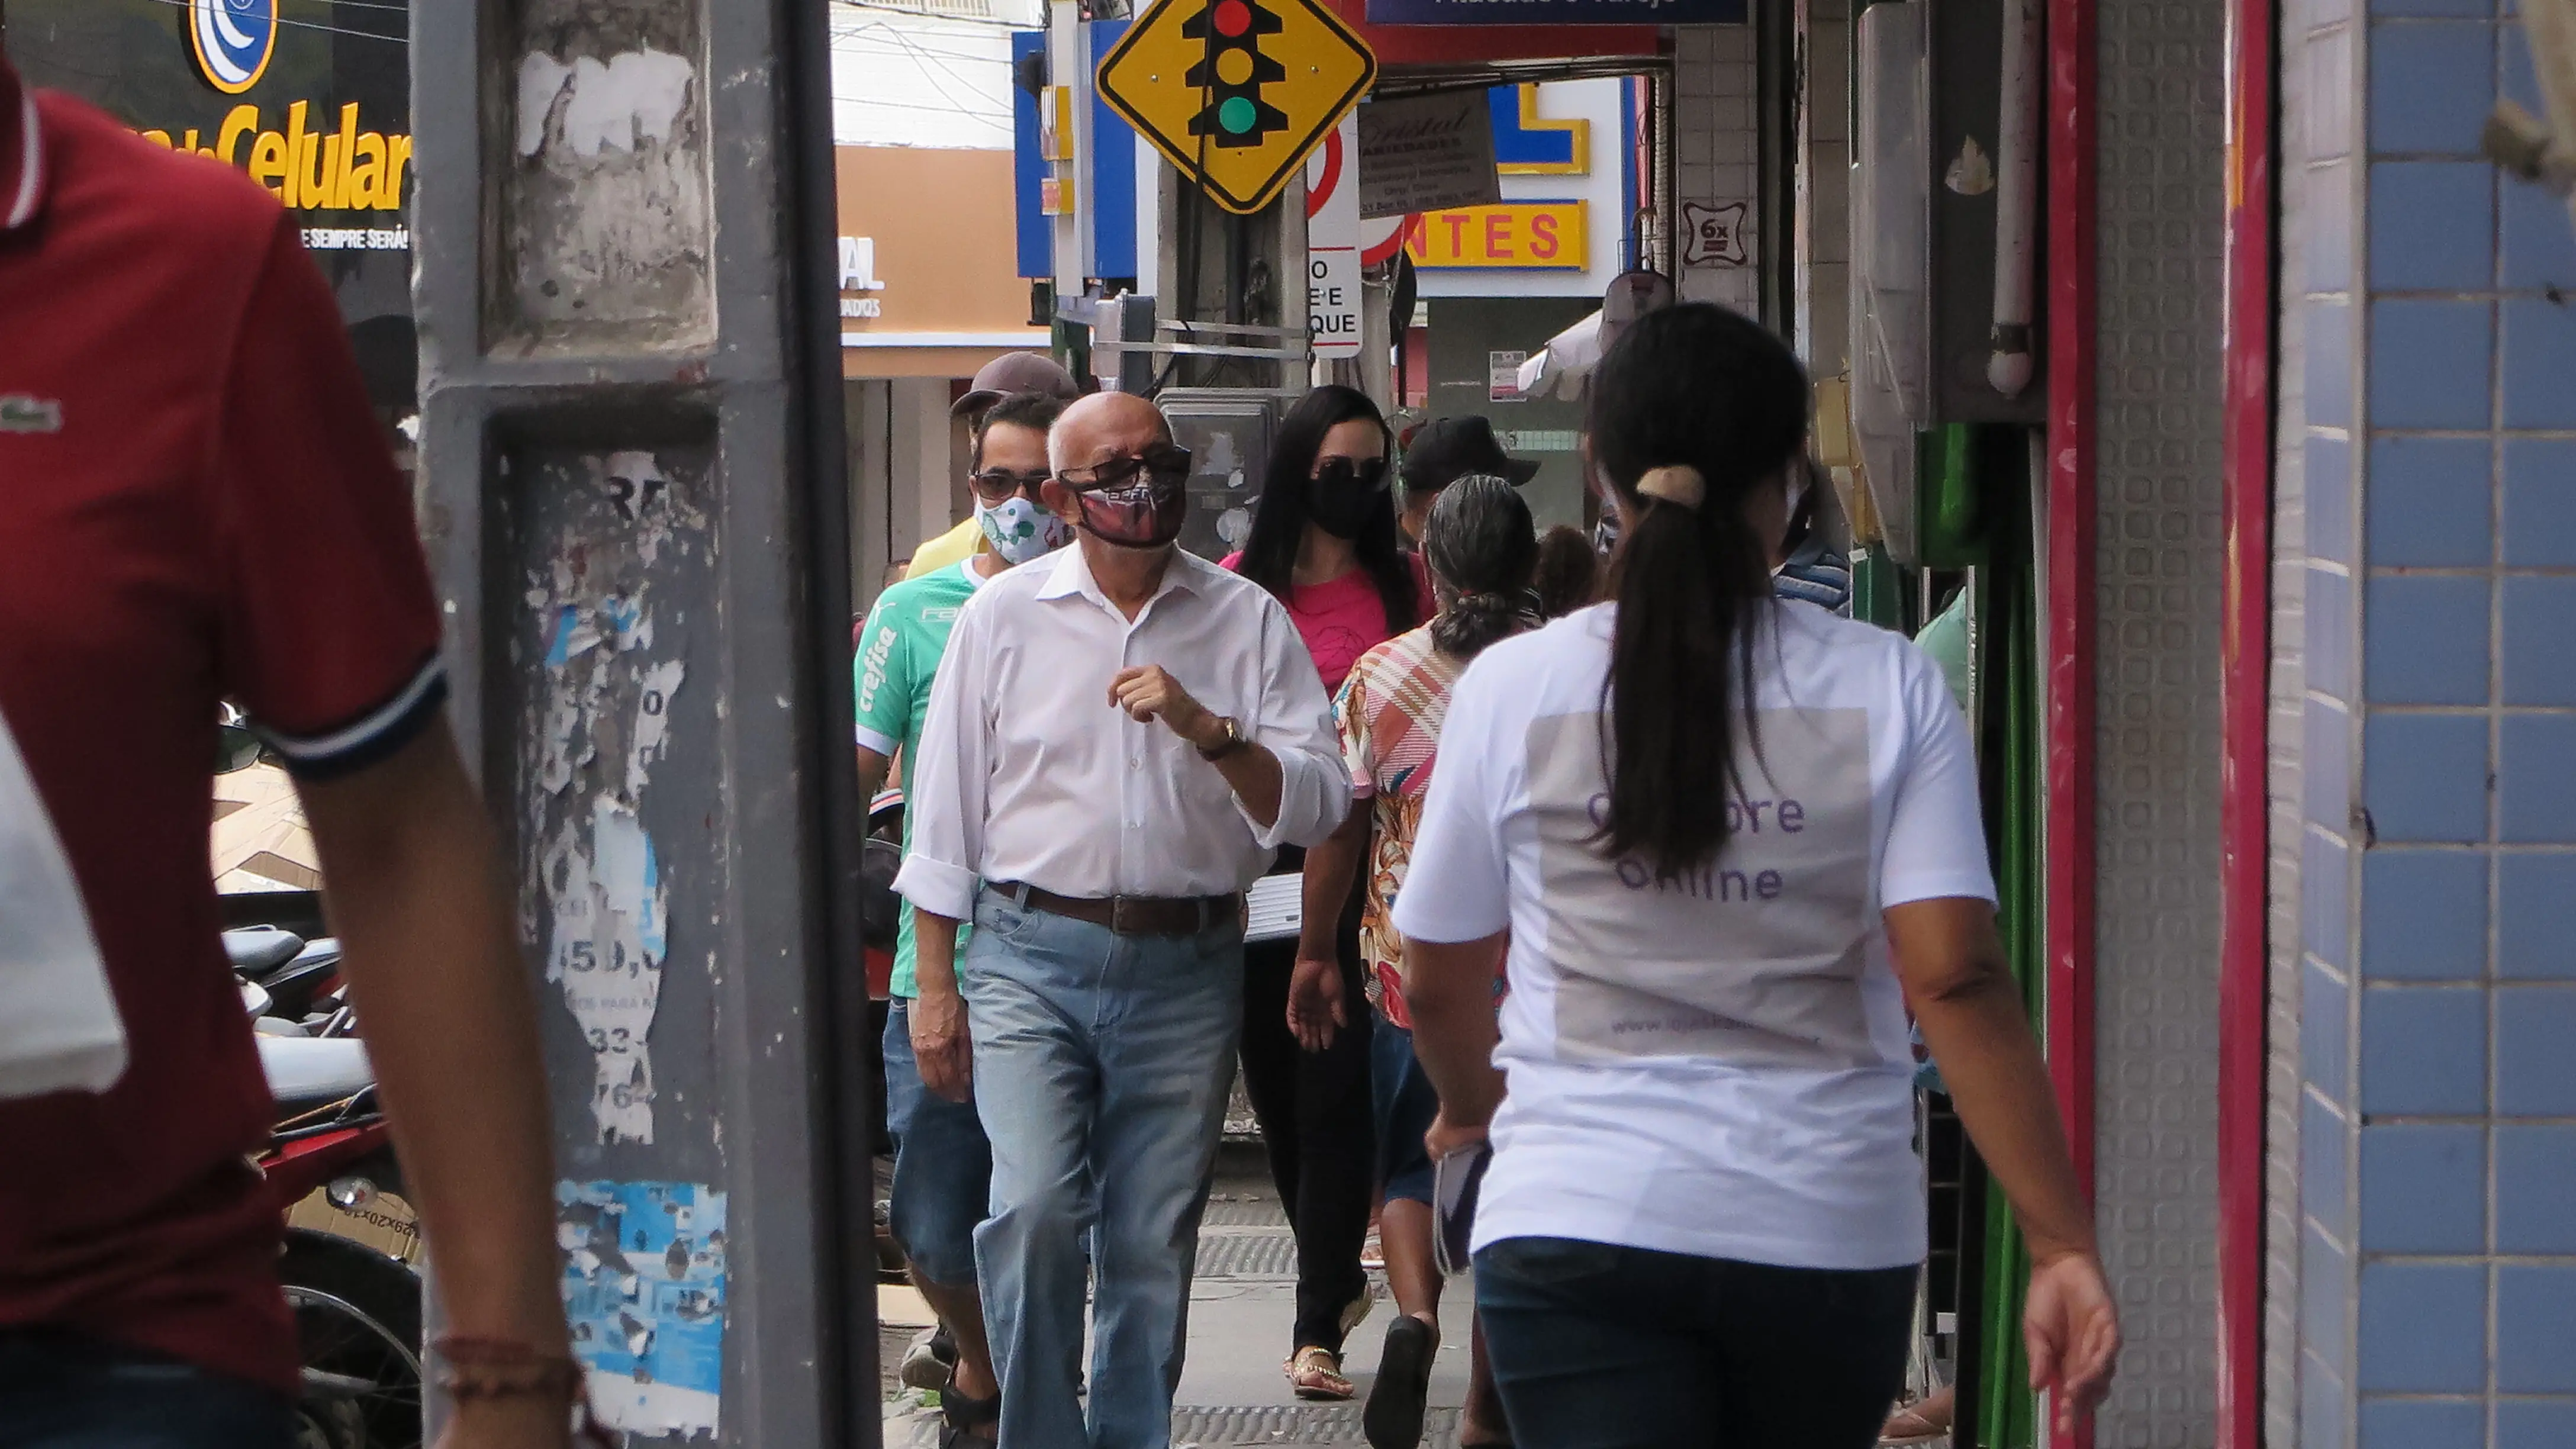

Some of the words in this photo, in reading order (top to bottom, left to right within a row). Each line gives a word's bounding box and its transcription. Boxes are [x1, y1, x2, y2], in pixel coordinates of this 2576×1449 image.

[311, 228, 366, 249] SEMPRE
[366, 223, 409, 249] SERÁ!
[1329, 287, 1343, 305] E
[859, 626, 898, 713] crefisa
